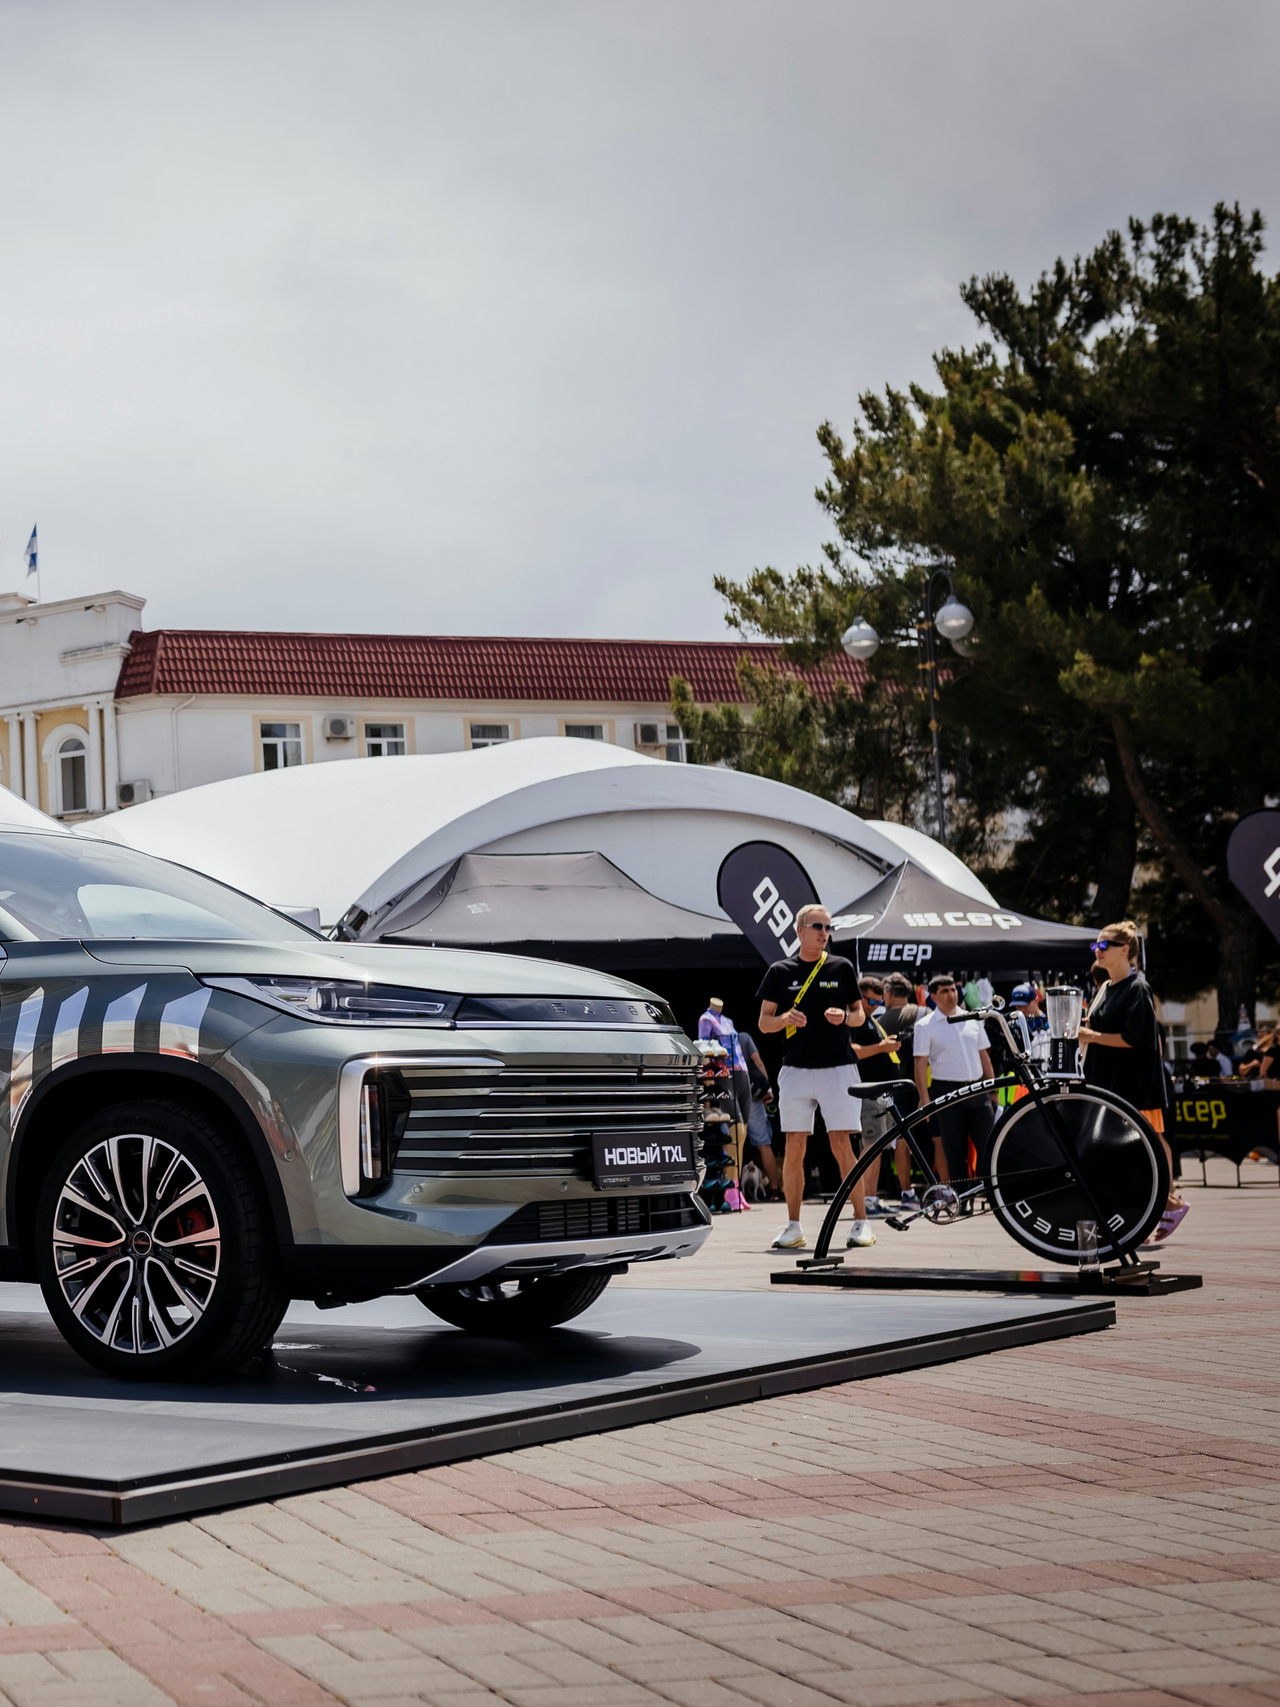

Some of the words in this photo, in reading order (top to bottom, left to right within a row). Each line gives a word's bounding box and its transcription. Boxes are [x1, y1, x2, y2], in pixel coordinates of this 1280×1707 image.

[943, 912, 1022, 930] cep
[889, 944, 933, 967] cep
[934, 1078, 995, 1106] EXEED
[1182, 1100, 1227, 1129] cep
[604, 1142, 661, 1166] НОВЫЙ
[662, 1145, 687, 1163] TXL
